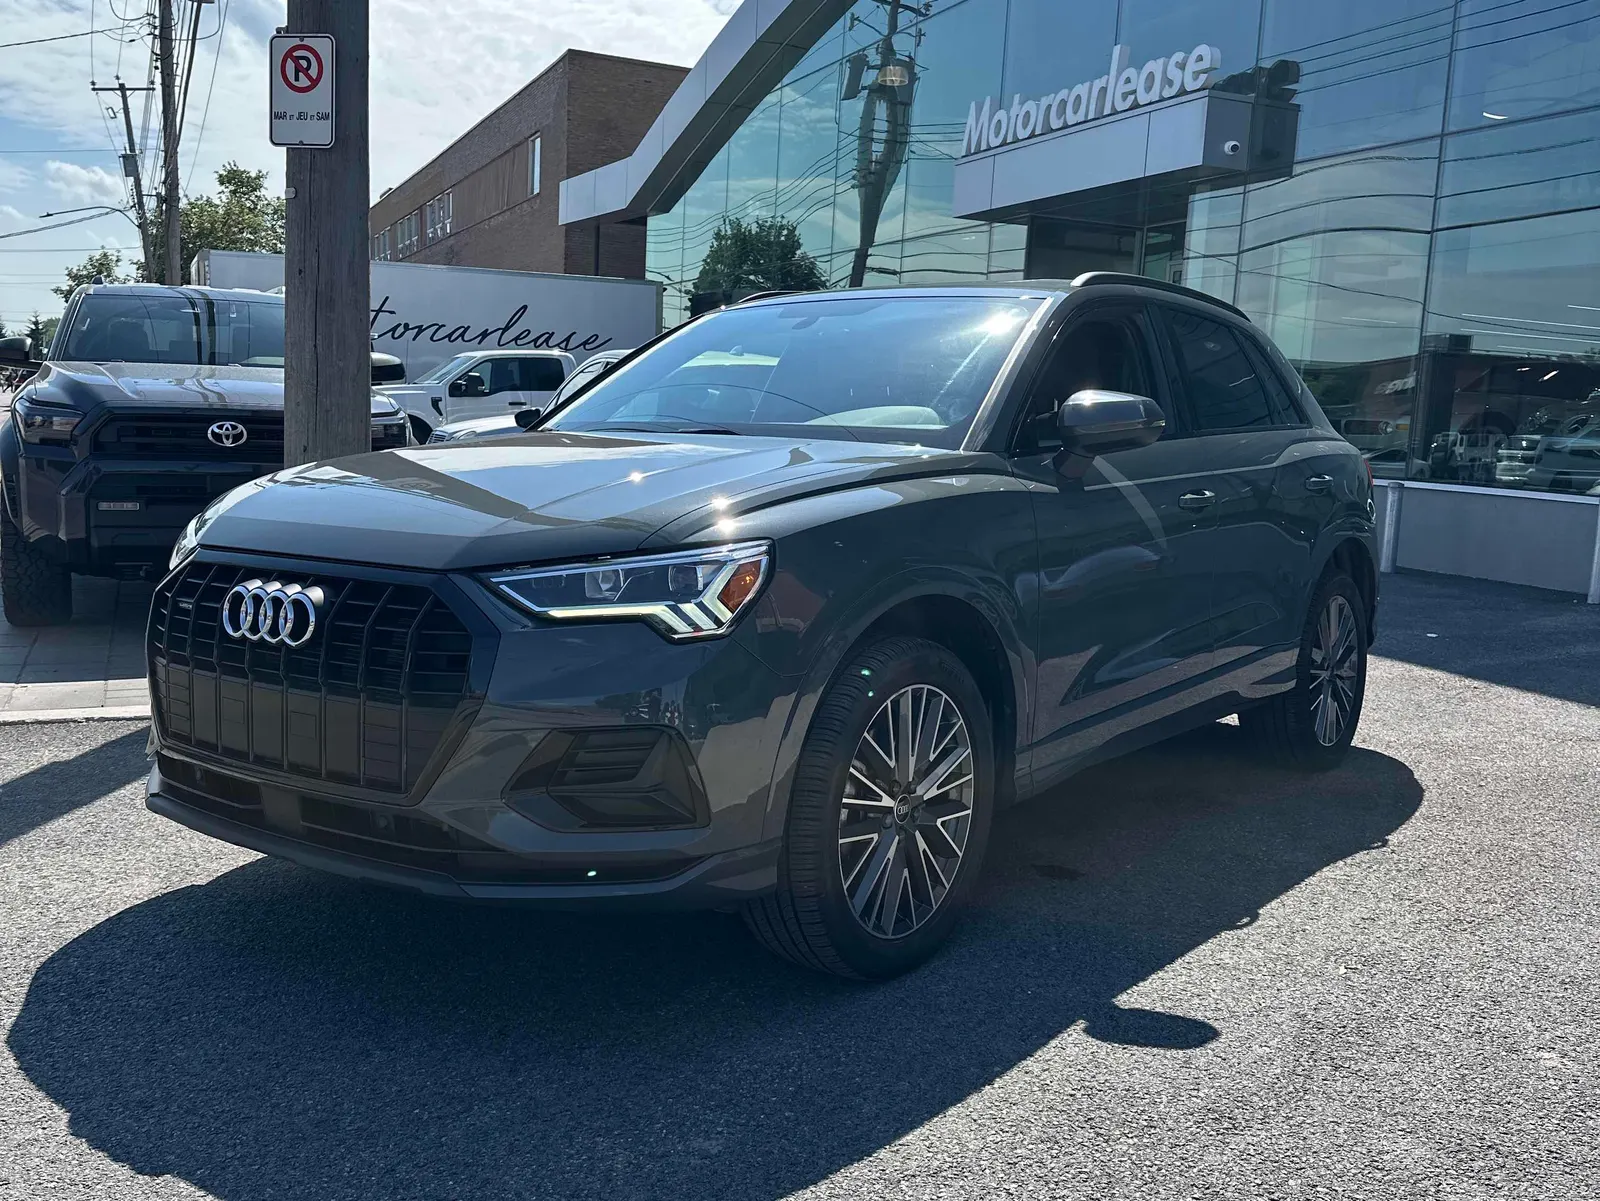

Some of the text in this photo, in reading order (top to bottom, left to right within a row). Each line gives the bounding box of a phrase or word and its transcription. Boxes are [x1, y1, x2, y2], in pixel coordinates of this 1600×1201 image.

[274, 111, 287, 120] MAR
[296, 111, 308, 121] JEU
[316, 111, 330, 121] SAM
[962, 44, 1221, 157] Motorcarlease
